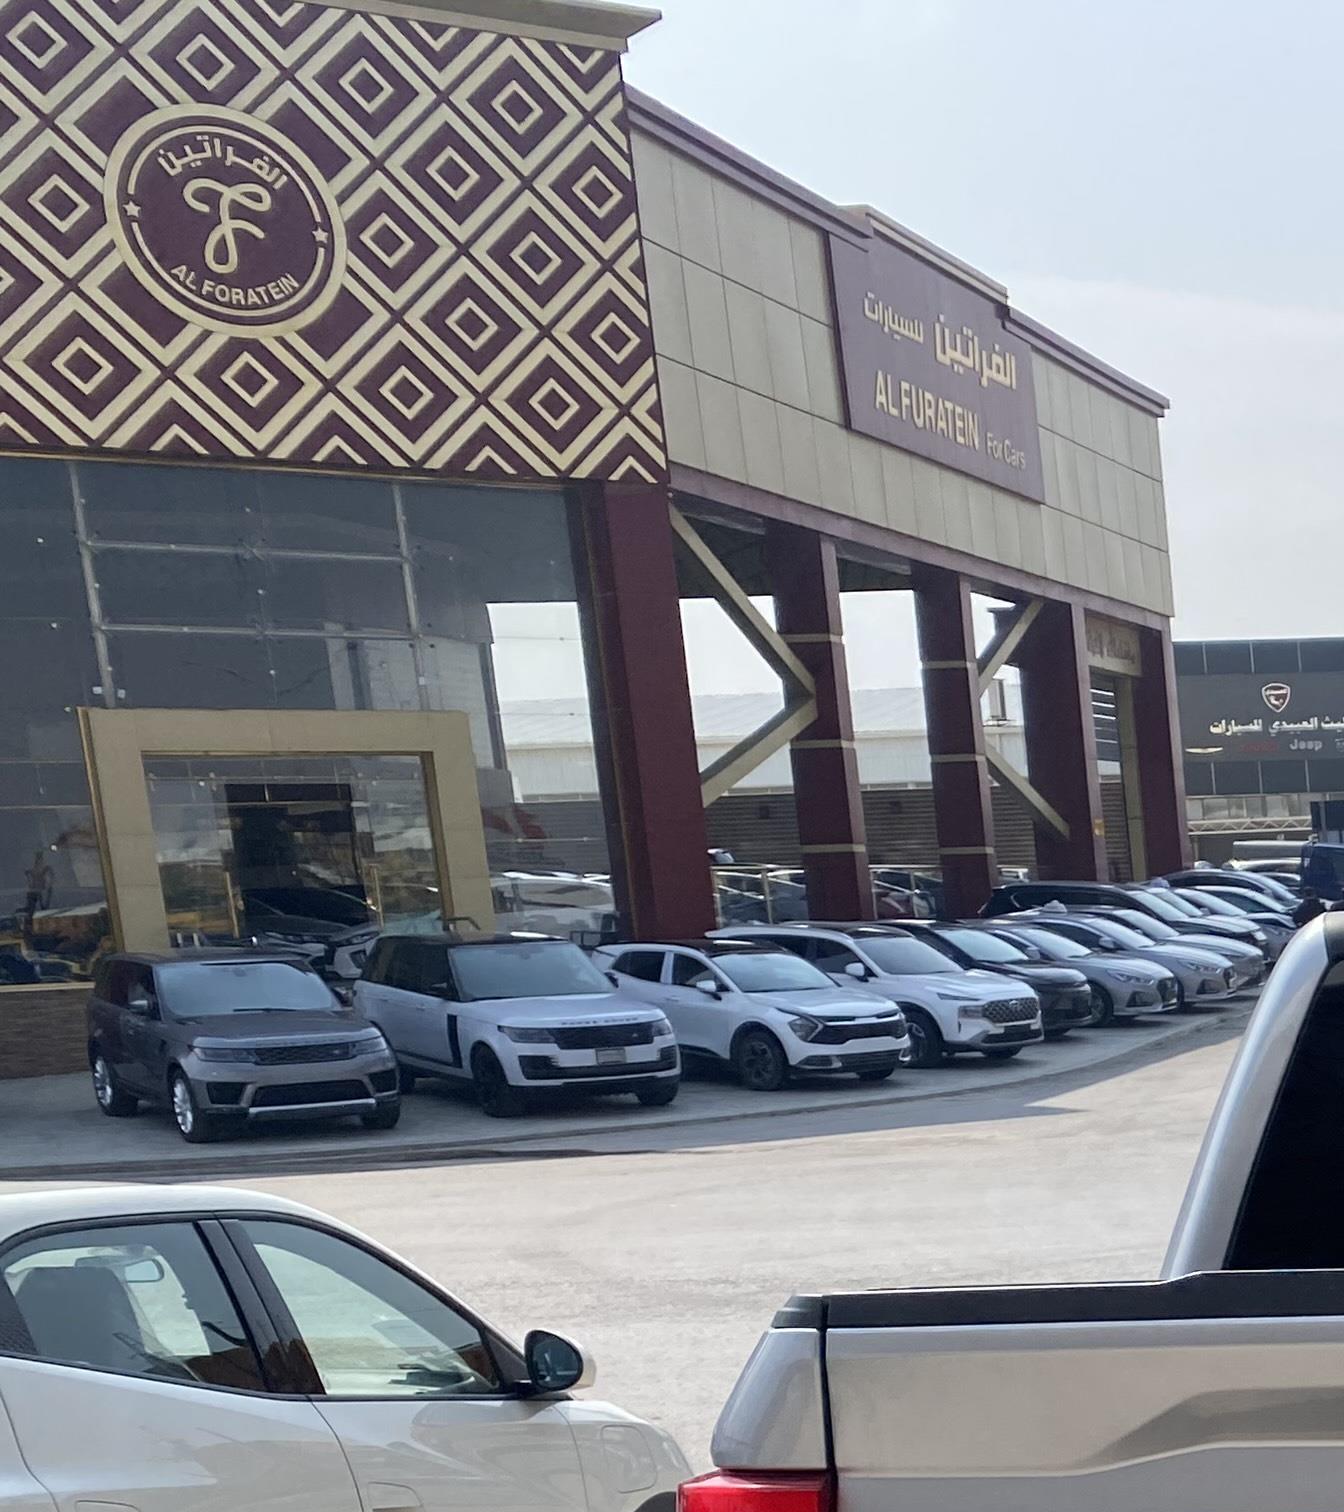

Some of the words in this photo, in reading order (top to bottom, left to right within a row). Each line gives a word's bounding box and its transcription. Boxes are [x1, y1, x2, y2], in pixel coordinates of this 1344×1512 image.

[158, 135, 288, 190] الفراتين
[170, 264, 197, 290] AL
[202, 273, 300, 305] FORATEIN
[933, 314, 1017, 390] الفراتين
[986, 431, 1004, 460] For
[1003, 440, 1026, 470] Cars
[1289, 738, 1323, 751] Jeep
